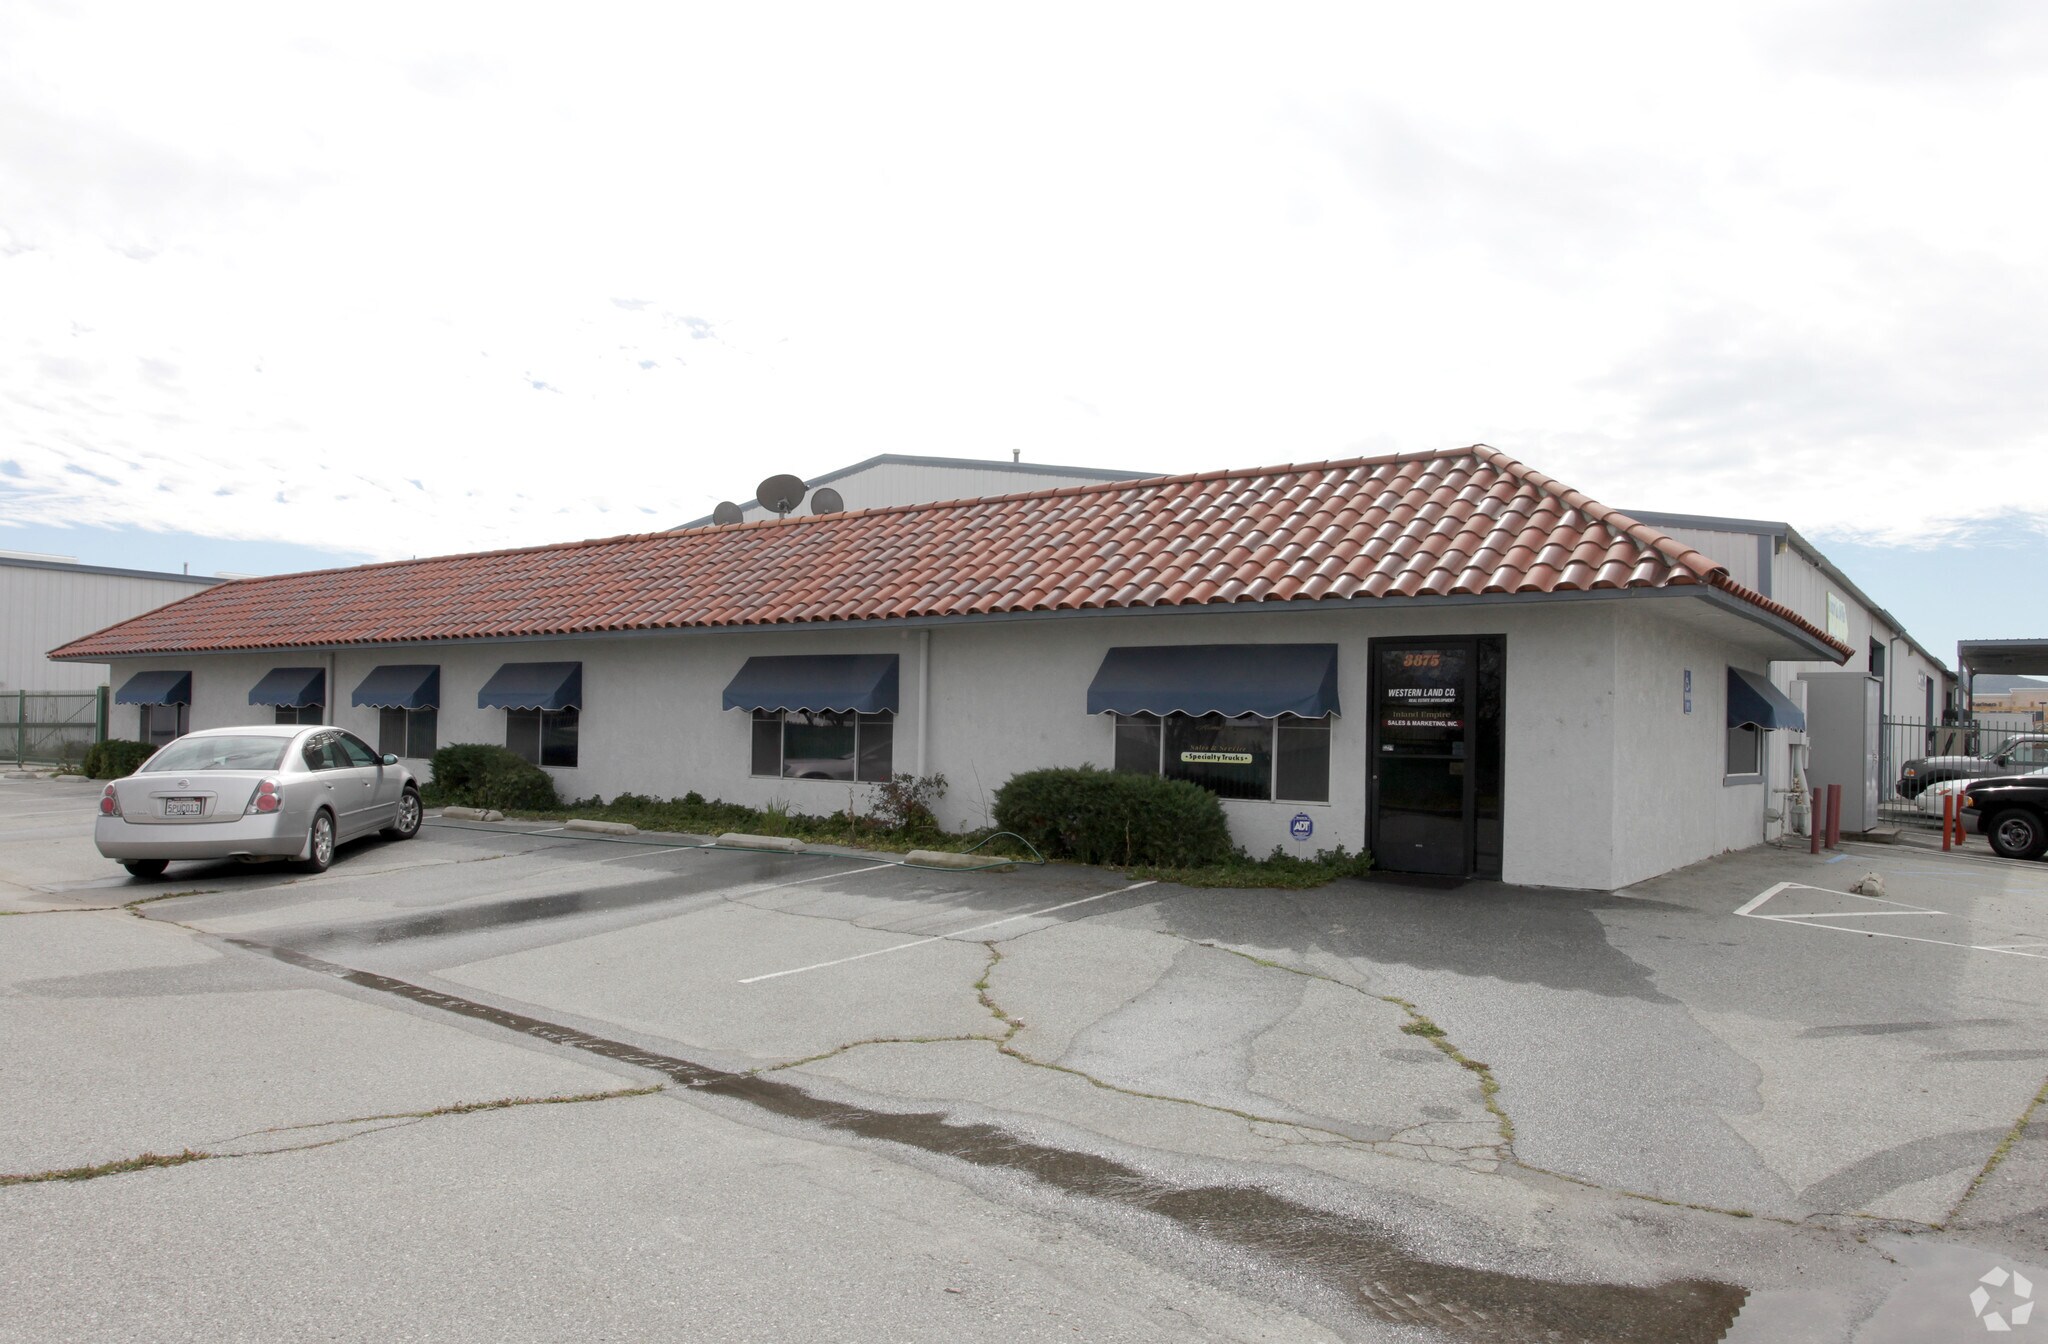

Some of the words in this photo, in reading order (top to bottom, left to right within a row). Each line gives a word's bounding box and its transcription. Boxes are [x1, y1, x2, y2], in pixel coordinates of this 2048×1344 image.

[1388, 688, 1422, 697] WESTERN
[1423, 688, 1443, 697] LAND
[1444, 688, 1456, 697] CO.
[1421, 711, 1452, 719] Empire
[1189, 753, 1220, 761] Specialty
[1293, 821, 1310, 831] ADT
